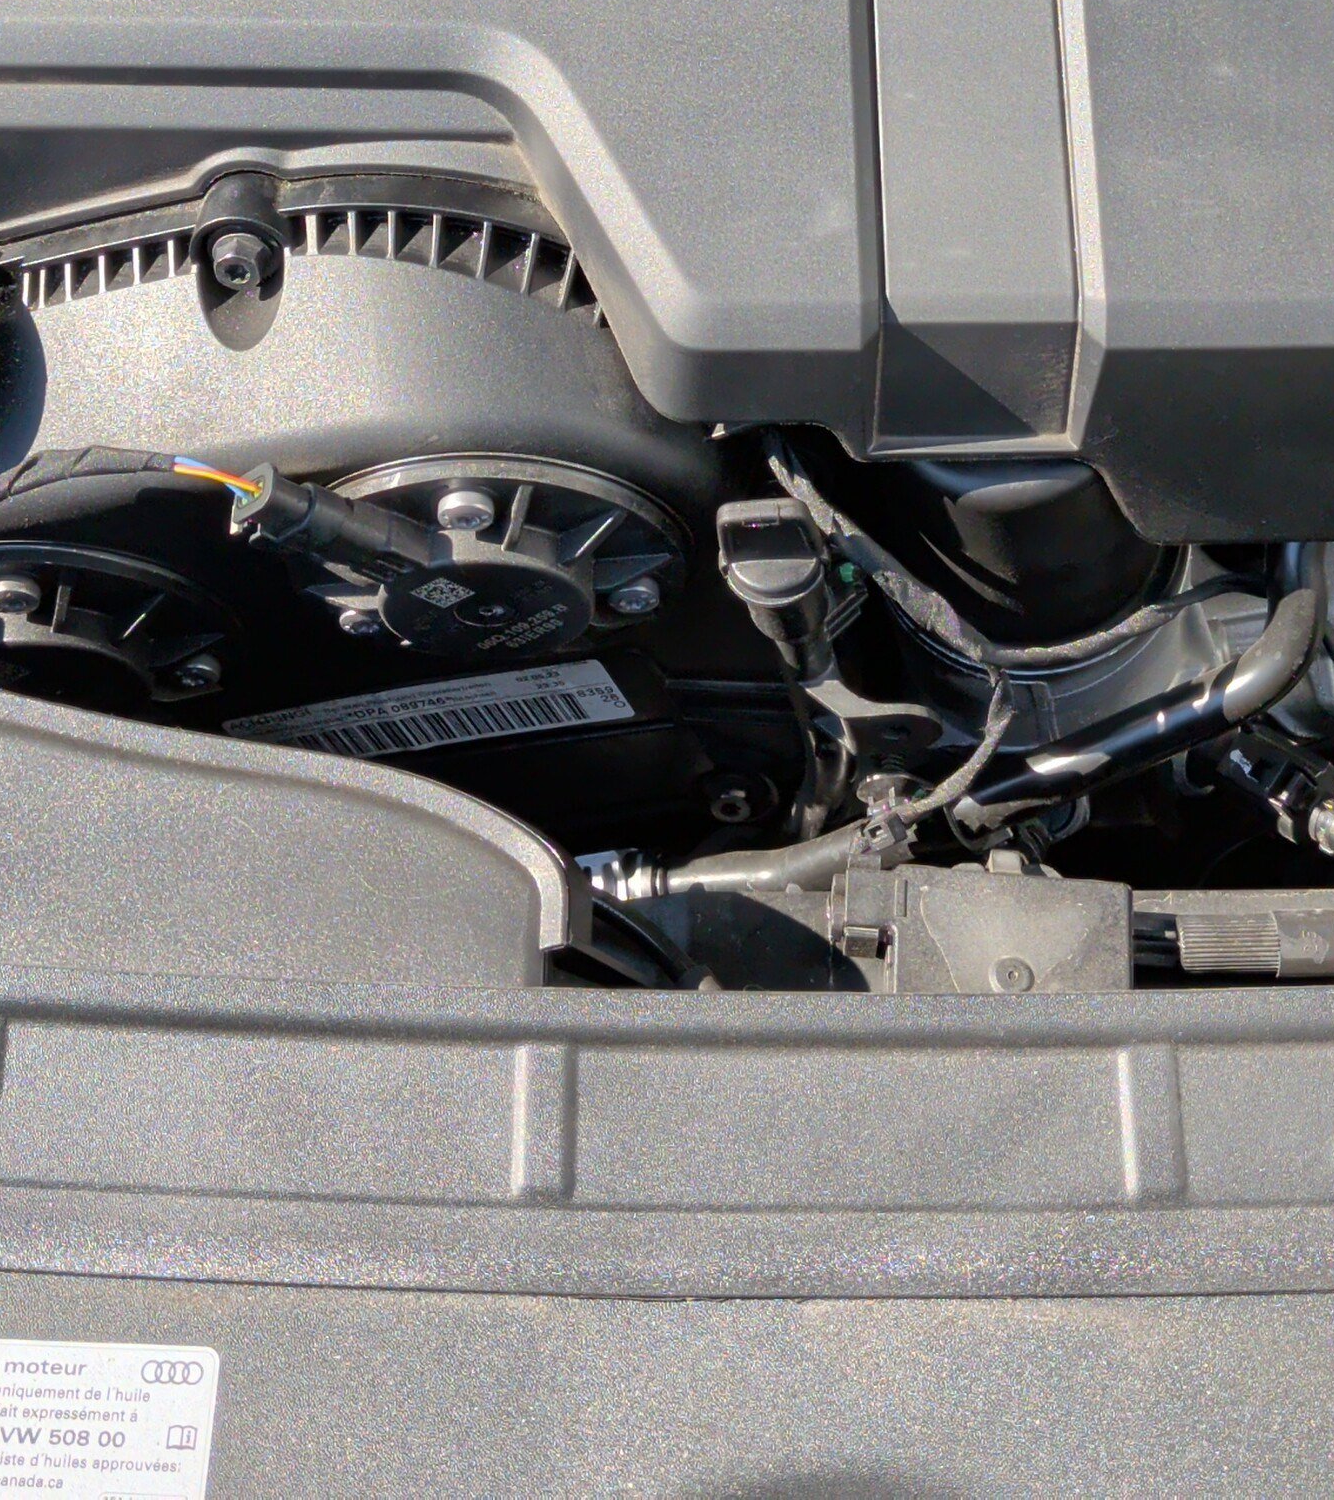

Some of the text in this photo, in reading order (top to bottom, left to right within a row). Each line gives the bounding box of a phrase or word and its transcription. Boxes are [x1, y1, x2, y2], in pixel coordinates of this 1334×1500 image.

[4, 1359, 87, 1376] moteur
[85, 1386, 101, 1401] de
[22, 1405, 125, 1423] expressément
[0, 1426, 41, 1444] VW
[48, 1429, 90, 1446] 508
[98, 1431, 126, 1448] 00
[92, 1458, 182, 1473] approuvées:
